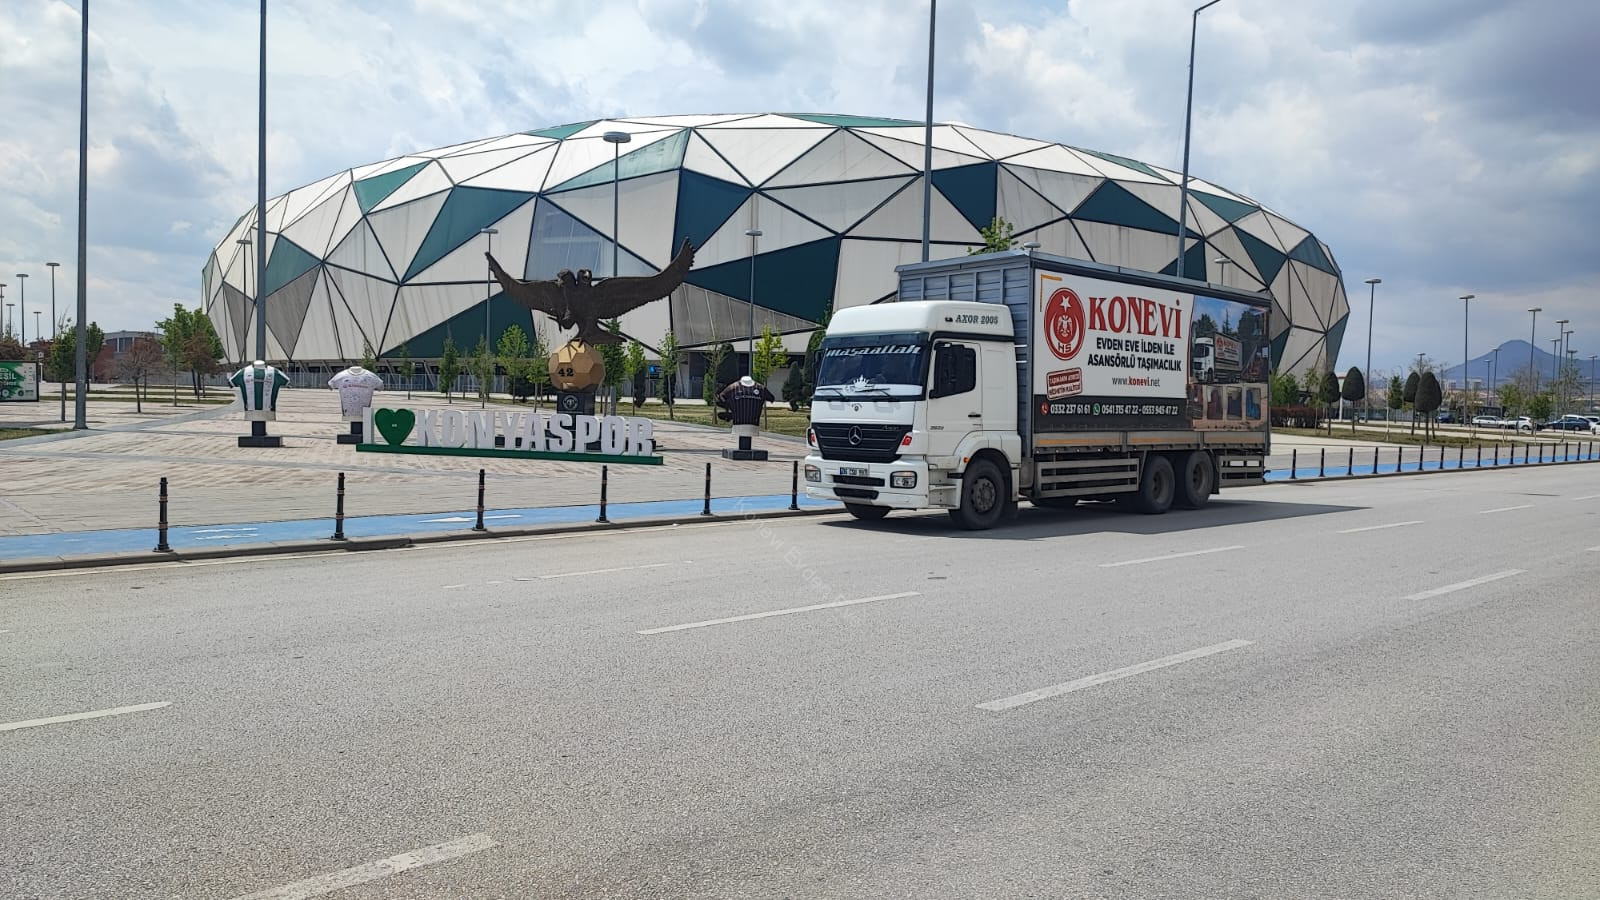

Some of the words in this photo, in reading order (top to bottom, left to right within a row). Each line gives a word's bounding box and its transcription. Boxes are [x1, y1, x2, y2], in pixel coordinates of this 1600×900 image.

[955, 314, 979, 324] AXOR
[1088, 296, 1182, 338] KONEVİ
[1058, 343, 1072, 354] HS
[1096, 338, 1124, 351] EVDEN
[1125, 339, 1140, 353] EVE
[1141, 339, 1163, 354] İLDEN
[1163, 341, 1175, 355] İLE
[1088, 353, 1136, 369] ASANSÖRLÜ
[1137, 357, 1182, 372] TAŞIMACILIK
[558, 368, 574, 377] 42
[1112, 376, 1160, 387] www.konevi.net
[1050, 404, 1066, 414] 0332
[416, 409, 654, 457] KONYASPOR
